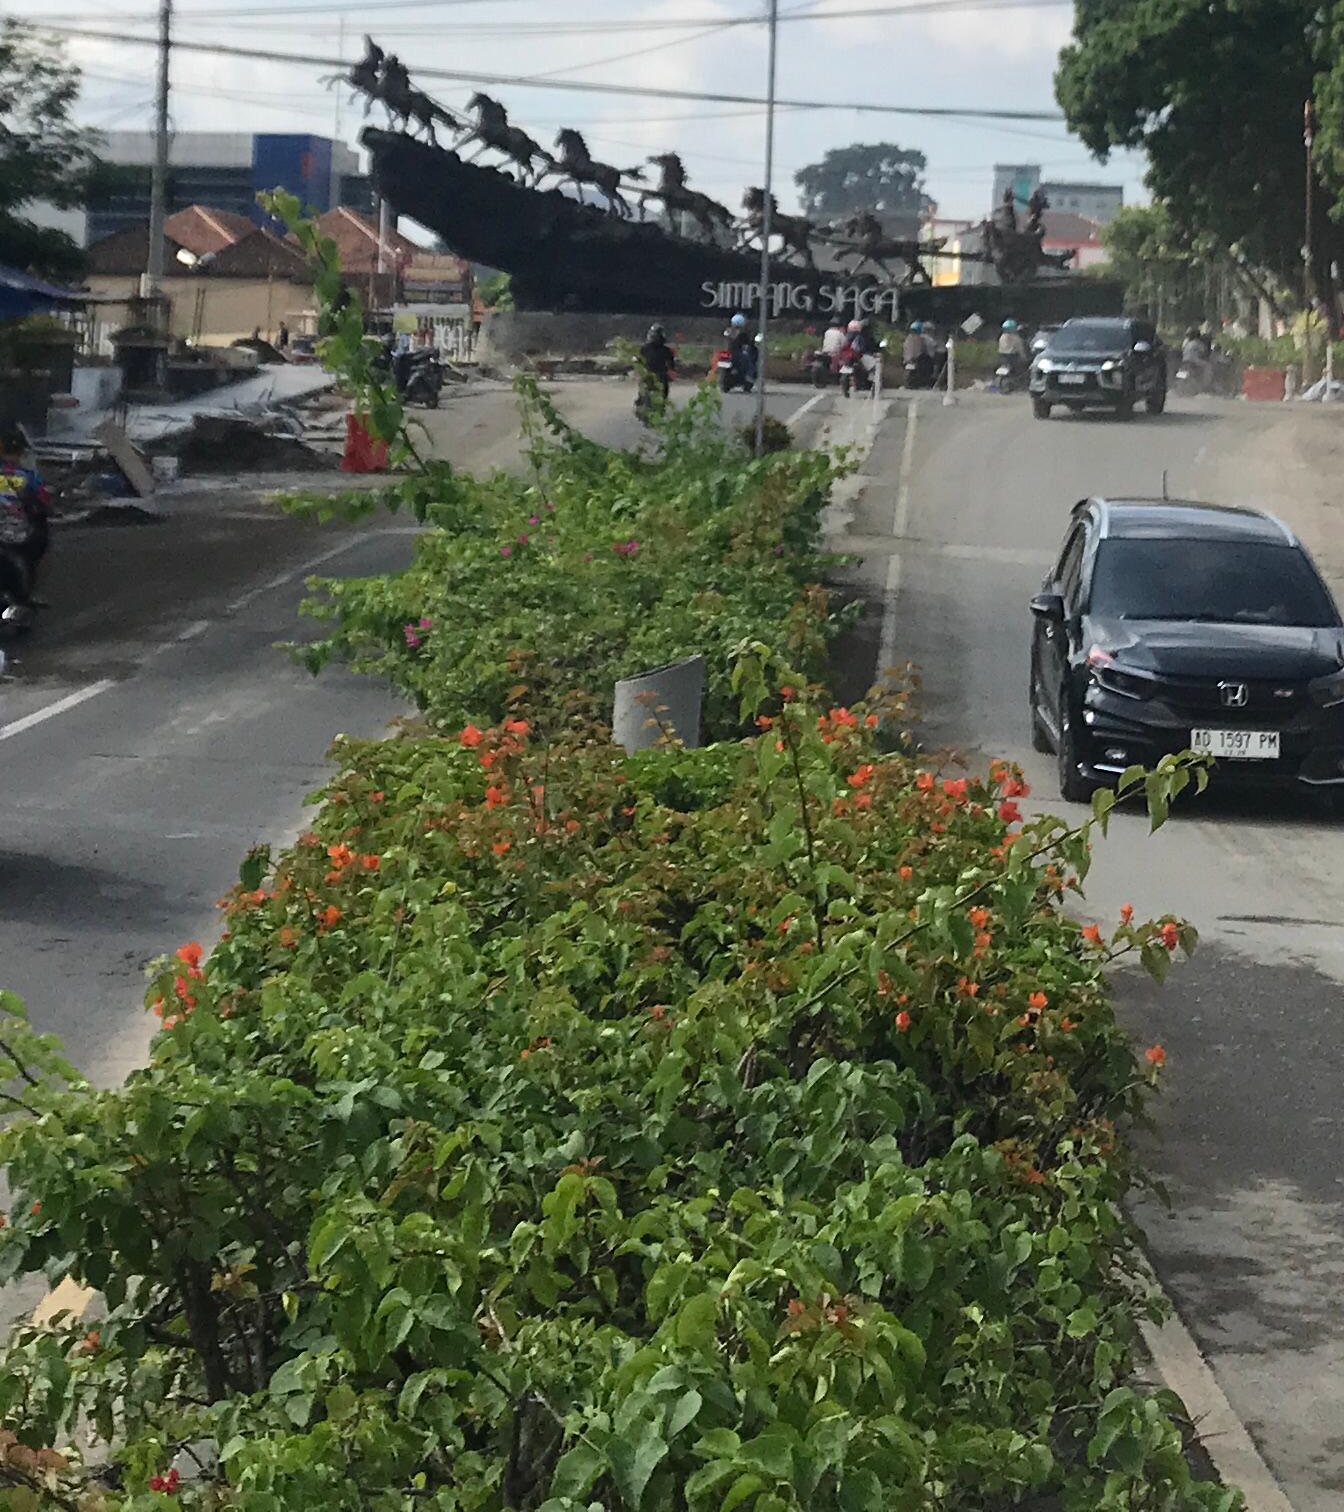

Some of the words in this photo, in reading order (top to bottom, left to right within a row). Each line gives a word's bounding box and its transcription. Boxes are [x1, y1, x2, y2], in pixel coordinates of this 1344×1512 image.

[700, 281, 812, 316] SIMPANG
[818, 286, 899, 322] SIAGA
[1194, 731, 1211, 748] AD
[1219, 732, 1251, 749] 1597
[1259, 734, 1277, 749] PM
